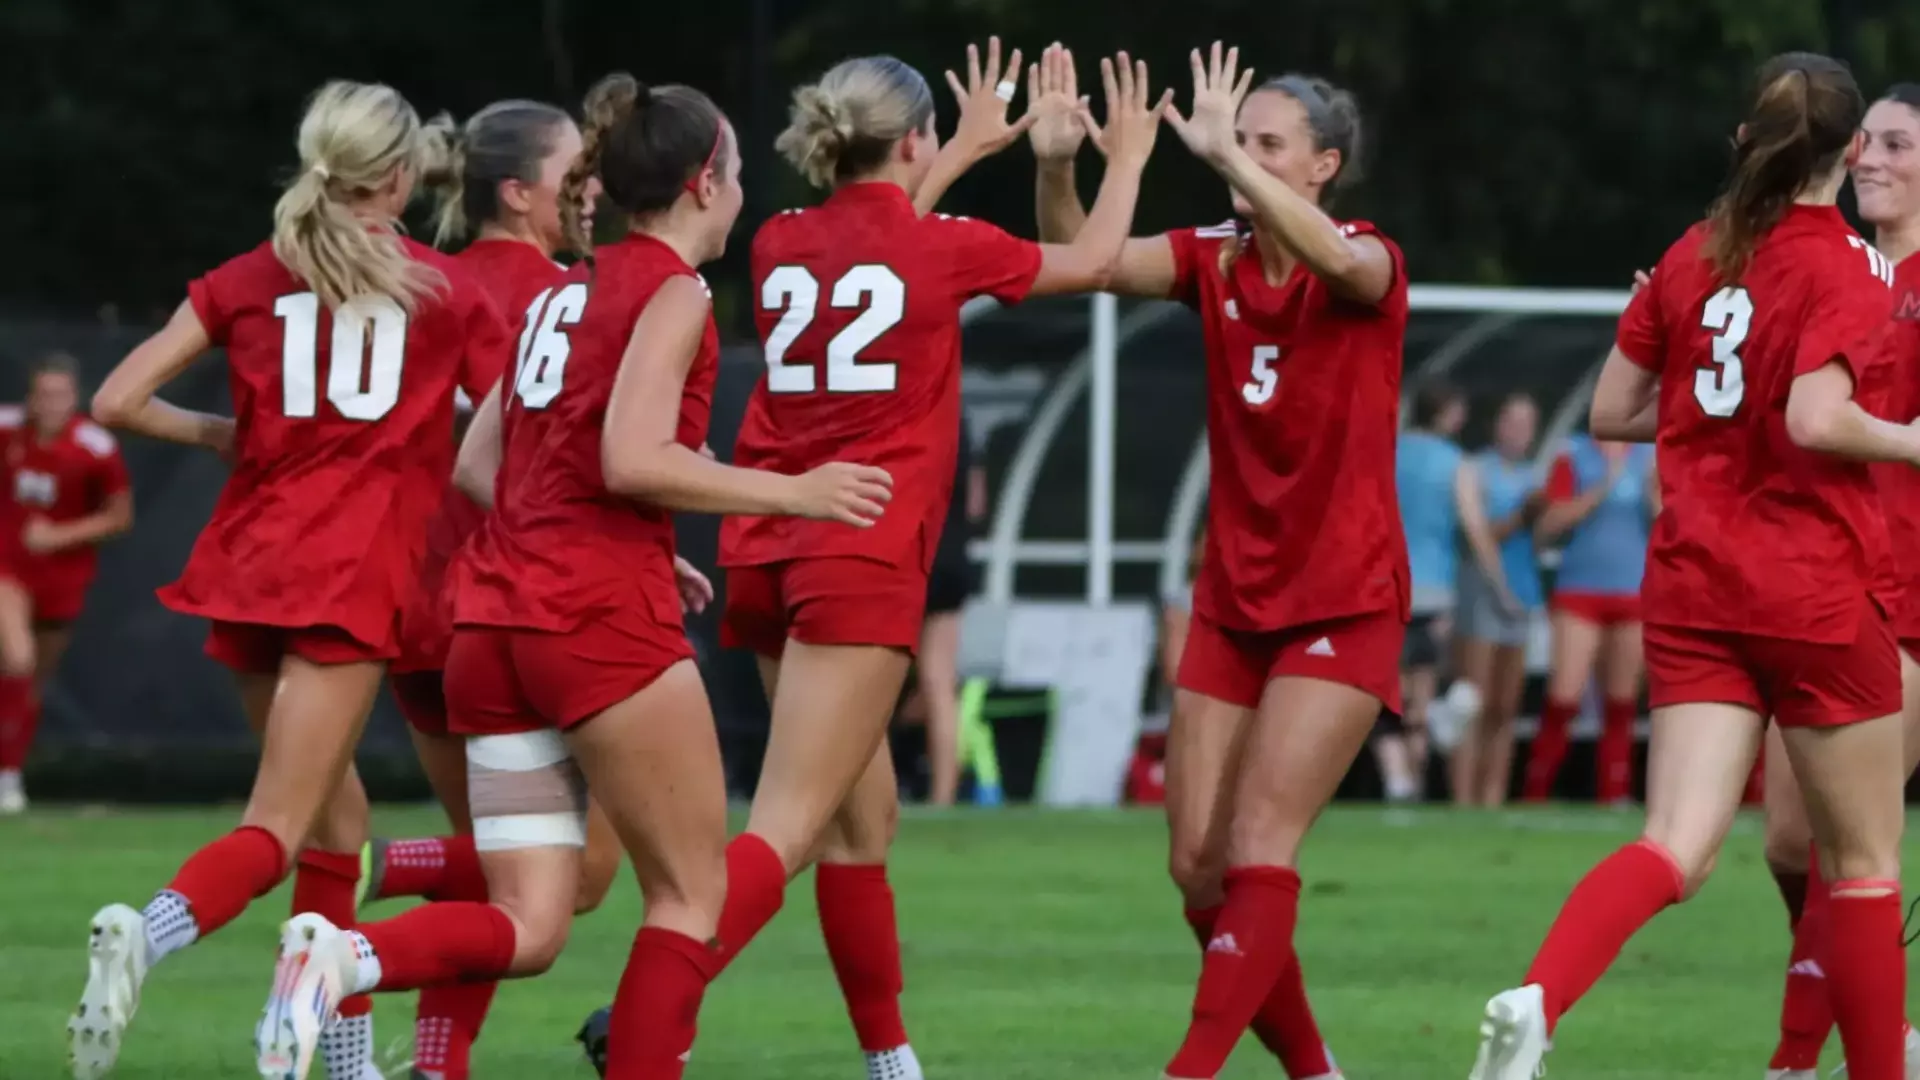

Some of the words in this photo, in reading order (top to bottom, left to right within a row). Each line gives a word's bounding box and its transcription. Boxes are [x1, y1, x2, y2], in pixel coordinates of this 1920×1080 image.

[273, 290, 408, 421] 10
[514, 282, 588, 410] 16
[761, 264, 906, 393] 22
[1242, 345, 1279, 405] 5
[1693, 285, 1754, 417] 3
